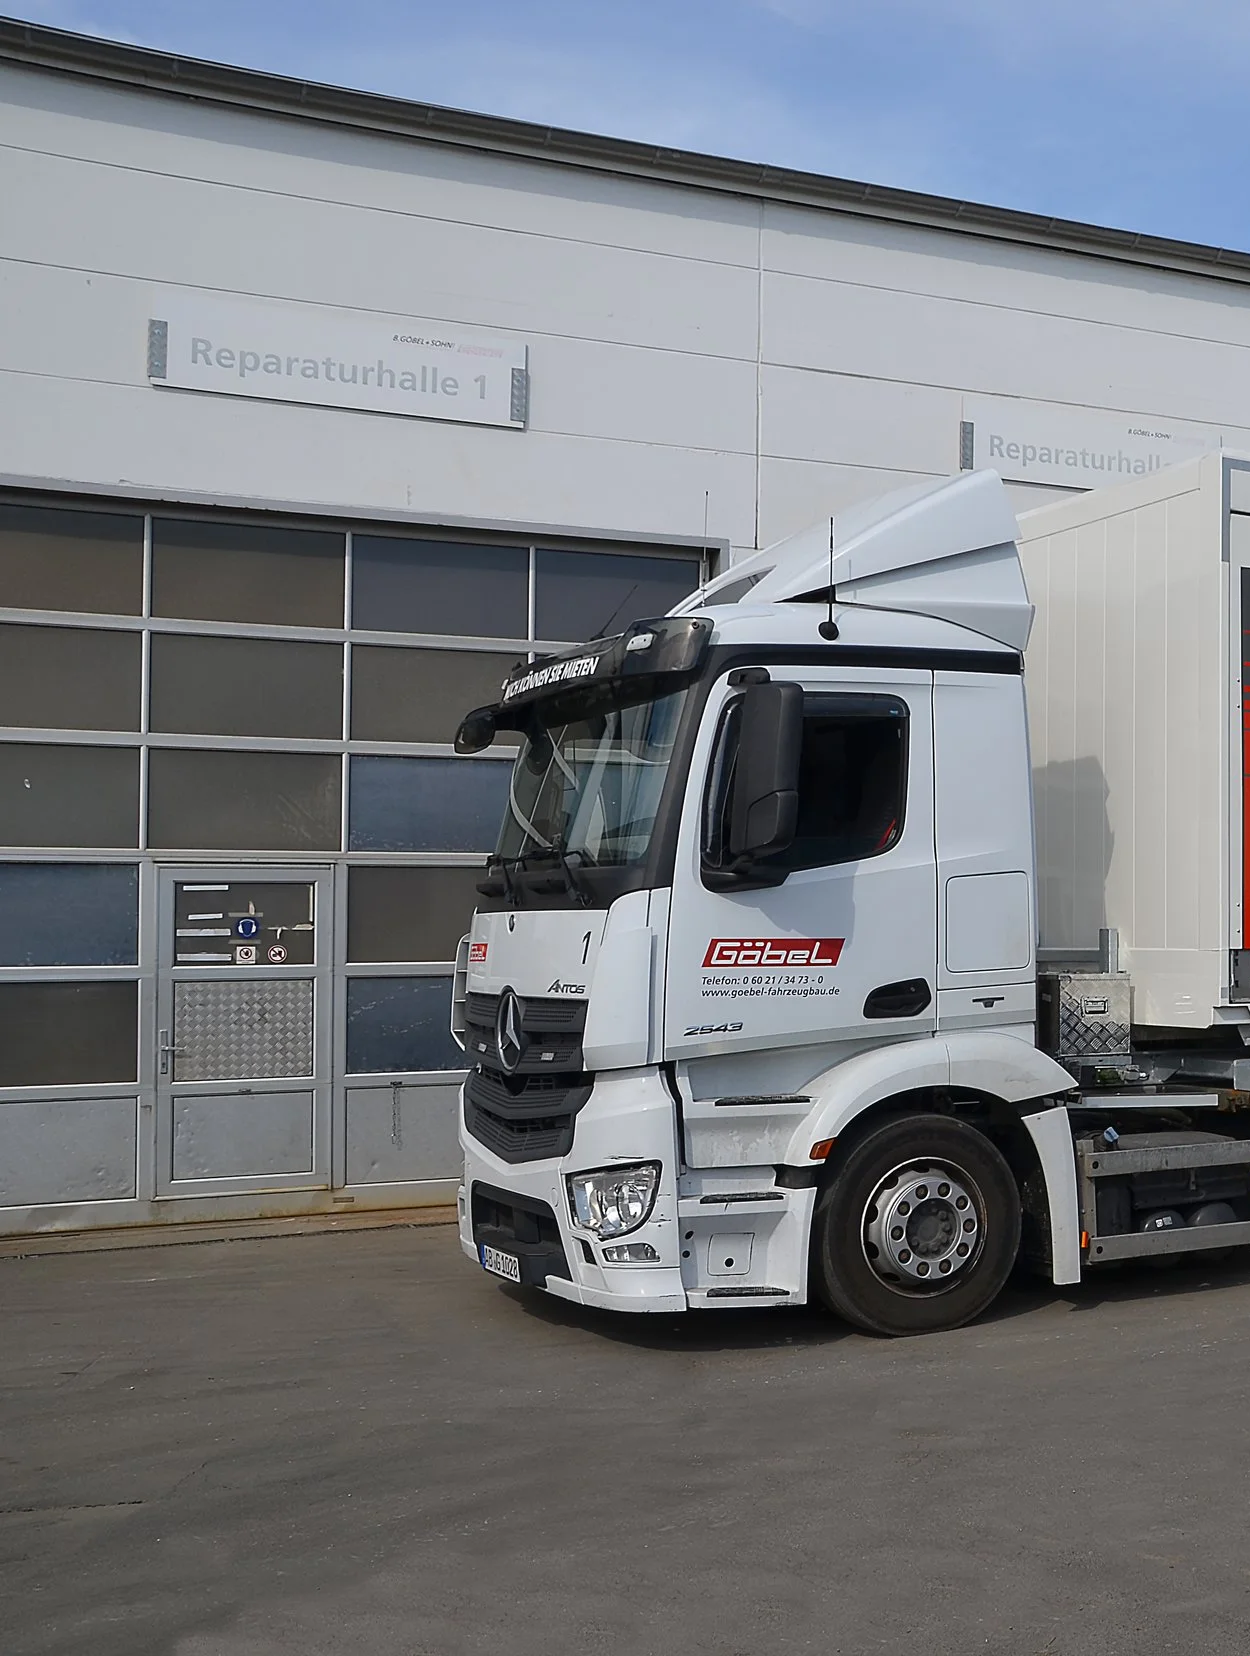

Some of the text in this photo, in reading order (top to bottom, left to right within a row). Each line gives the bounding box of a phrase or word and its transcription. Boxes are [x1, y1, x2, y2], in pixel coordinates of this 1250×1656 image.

[190, 336, 488, 400] Reparaturhalle 1
[989, 434, 1170, 476] Reparaturhall
[582, 930, 592, 965] 1
[701, 986, 840, 998] www.goebel-fahrzeugbau.de
[702, 976, 741, 986] Telefon:
[742, 976, 749, 985] 0
[751, 976, 763, 985] 60
[765, 976, 776, 985] 21
[784, 976, 796, 985] 34
[798, 976, 809, 985] 73
[817, 975, 824, 984] 0
[683, 1022, 744, 1037] 2543
